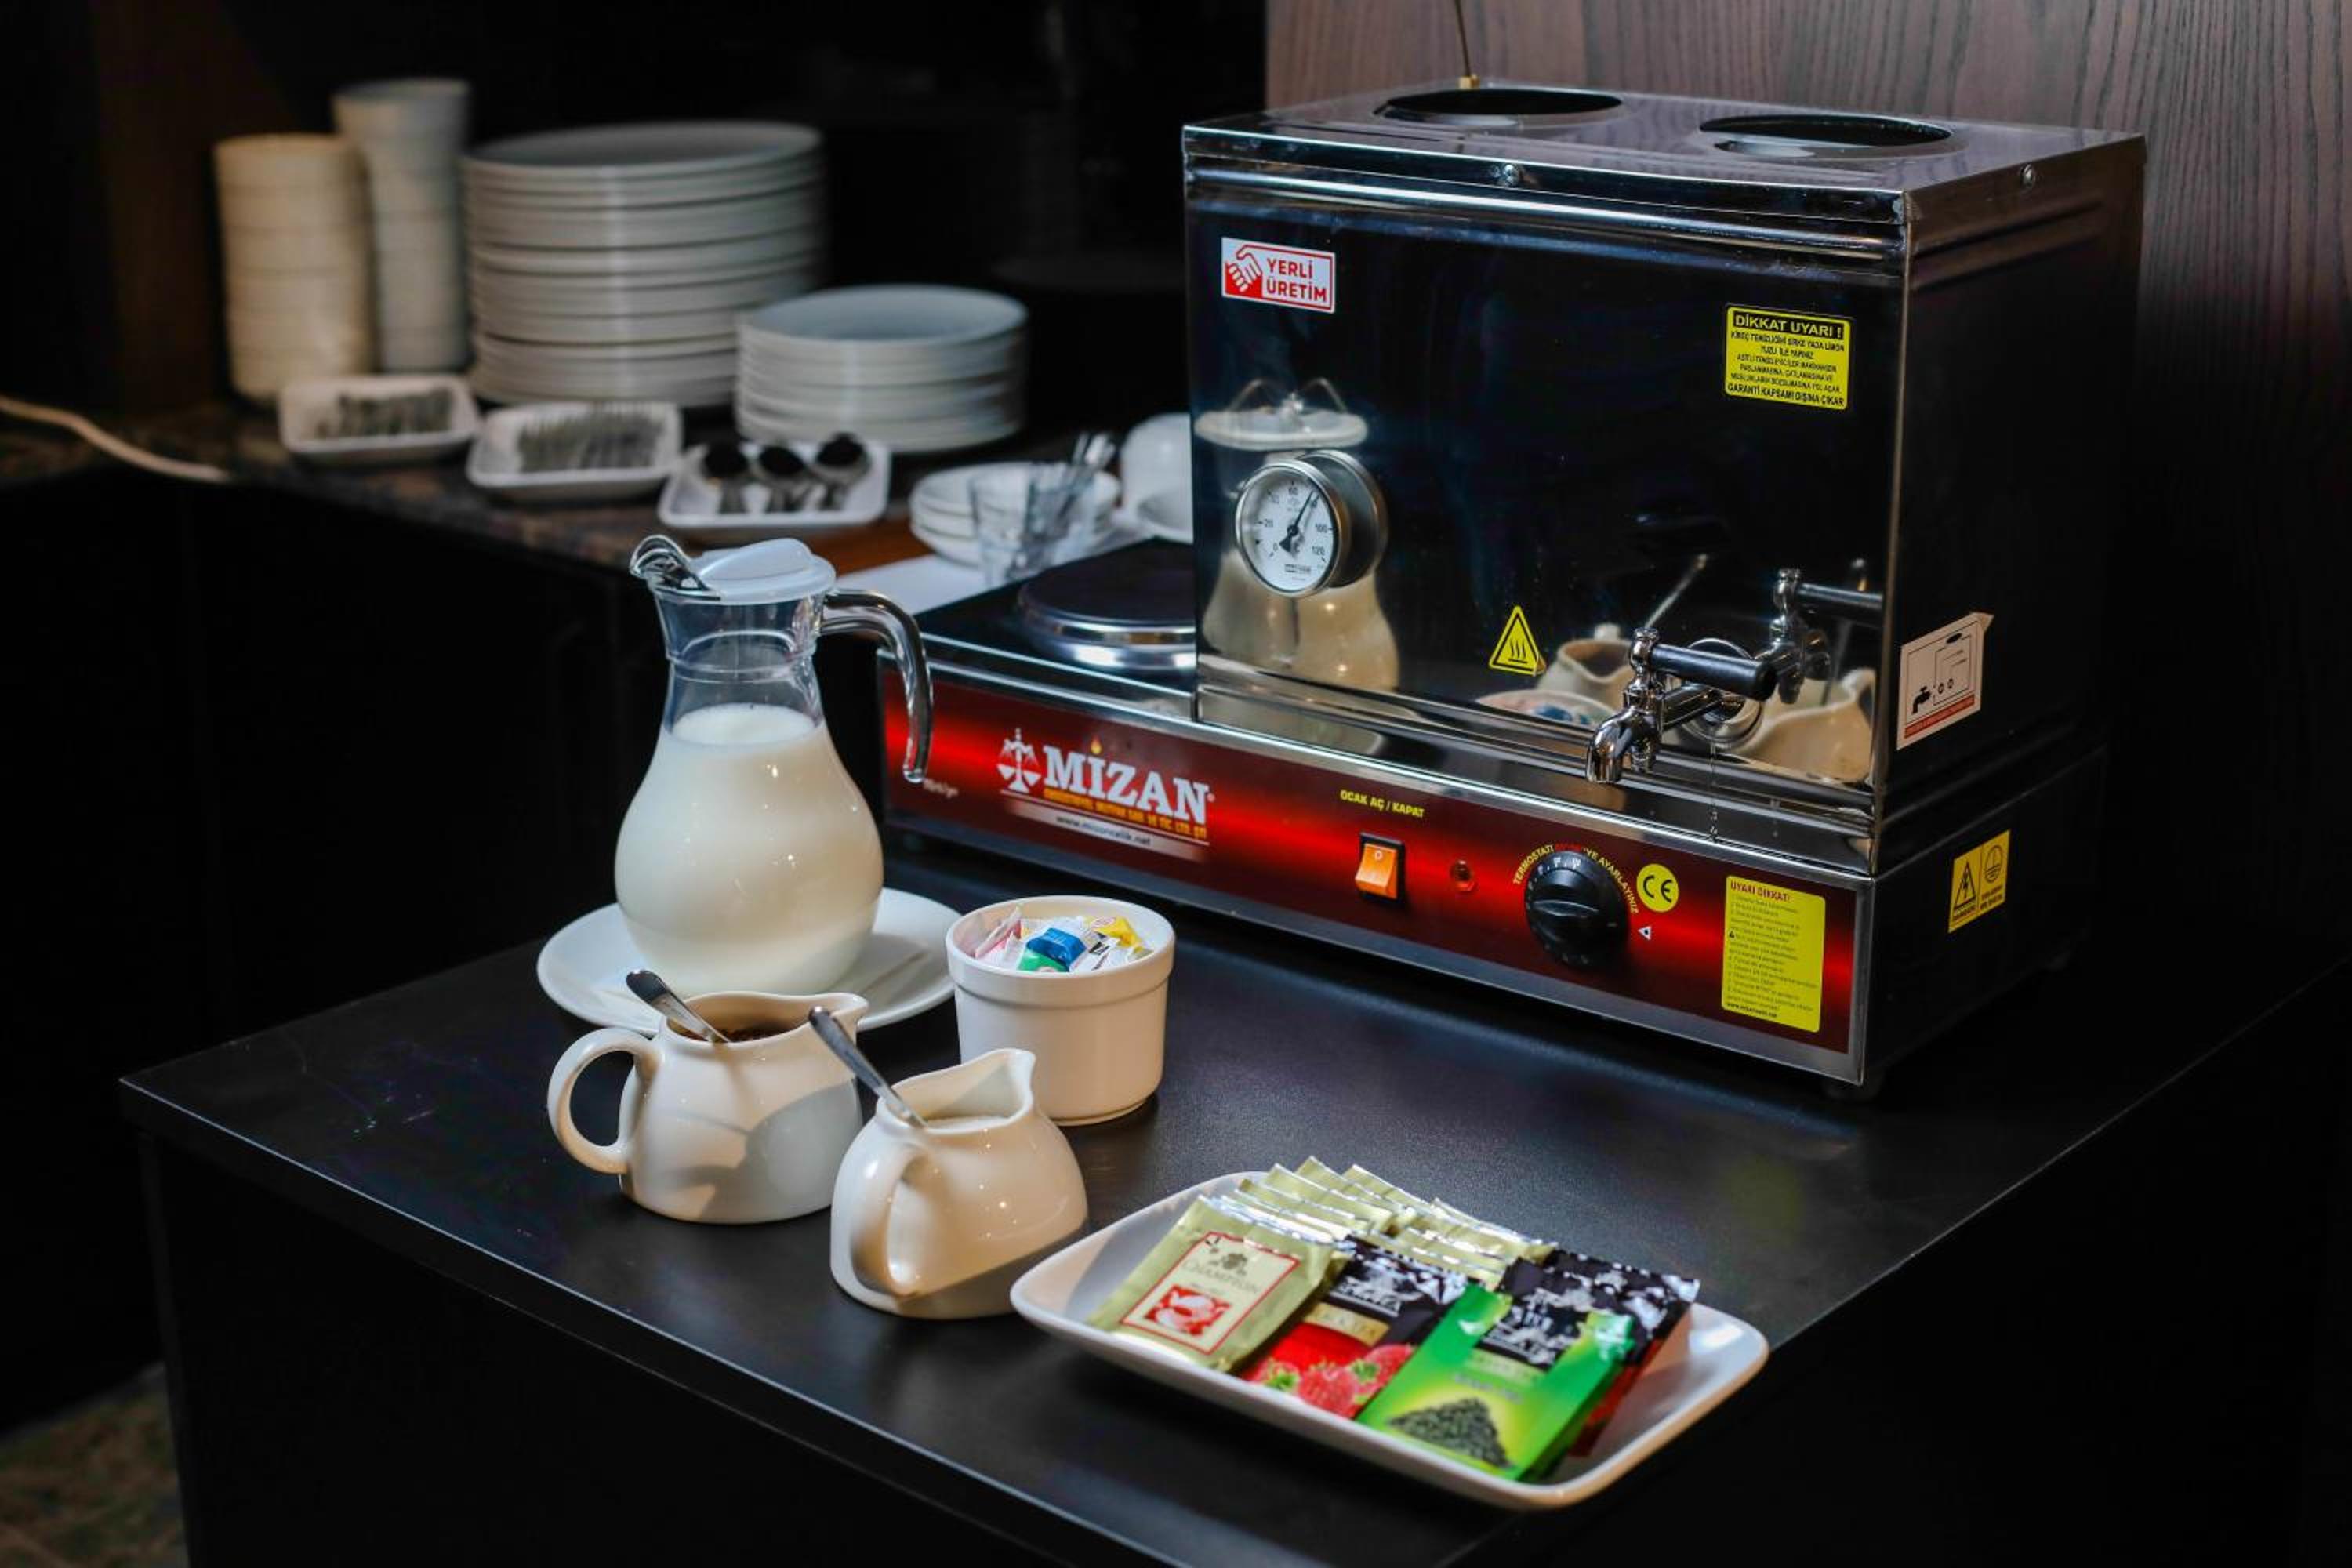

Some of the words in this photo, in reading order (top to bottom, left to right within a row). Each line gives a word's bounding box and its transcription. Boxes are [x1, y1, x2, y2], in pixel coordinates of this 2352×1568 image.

[1267, 258, 1313, 279] YERLİ
[1266, 276, 1327, 303] ÜRETİM
[1735, 314, 1787, 331] DİKKAT
[1790, 321, 1832, 337] UYARI
[1340, 789, 1367, 805] OCAK
[1370, 796, 1383, 811] AÇ
[1392, 802, 1425, 818] KAPAT
